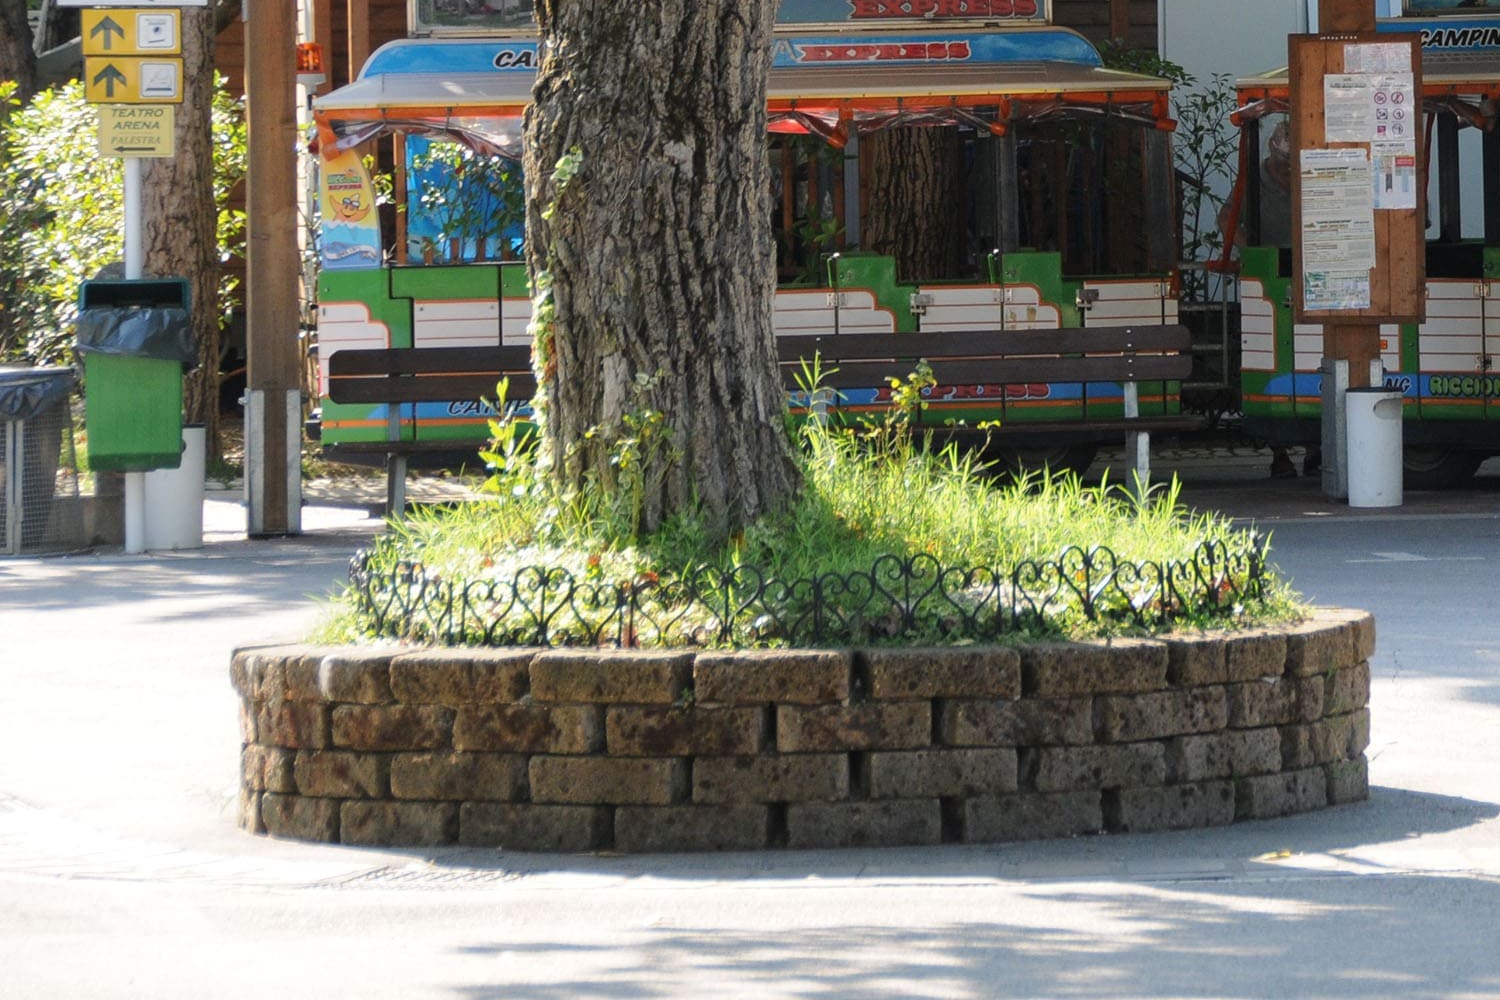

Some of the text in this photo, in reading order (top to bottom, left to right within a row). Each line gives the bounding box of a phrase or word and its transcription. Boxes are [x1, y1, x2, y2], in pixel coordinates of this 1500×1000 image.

[111, 108, 164, 118] TEATRO
[113, 121, 160, 130] ARENA
[110, 135, 161, 145] PALESTRA
